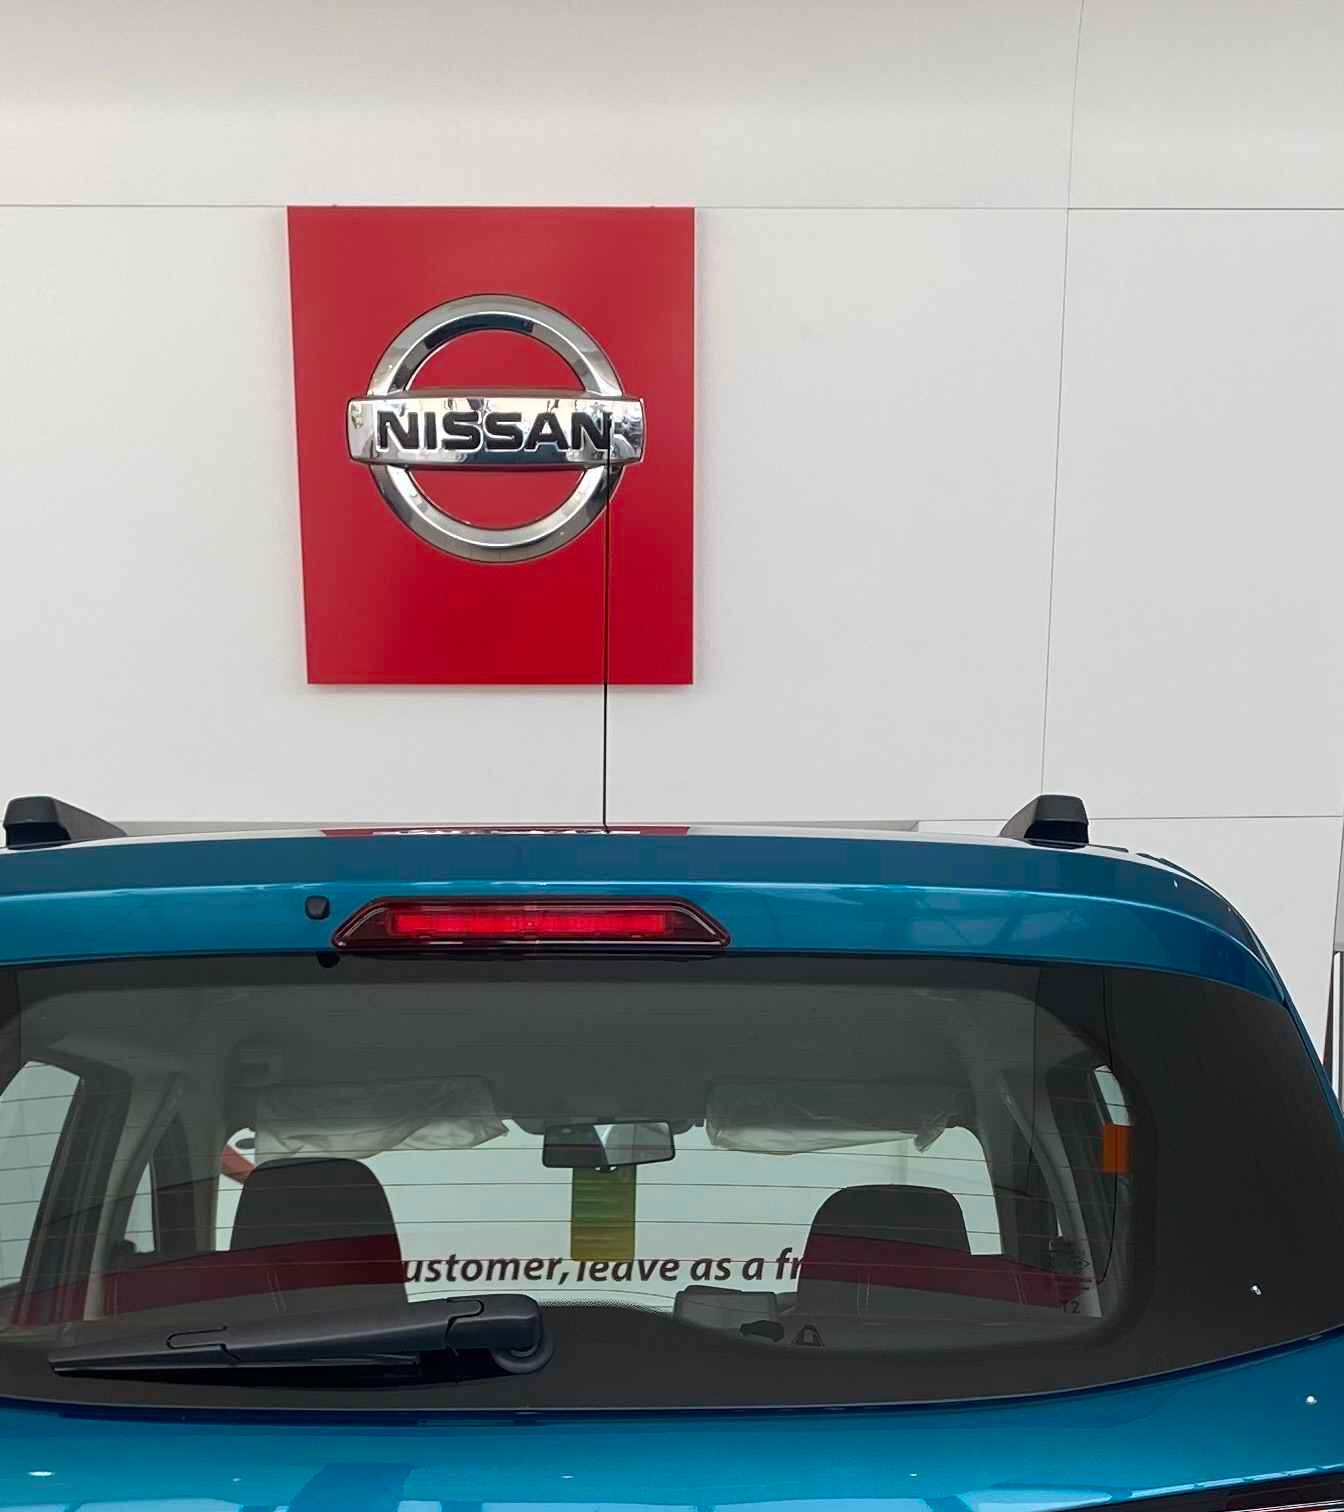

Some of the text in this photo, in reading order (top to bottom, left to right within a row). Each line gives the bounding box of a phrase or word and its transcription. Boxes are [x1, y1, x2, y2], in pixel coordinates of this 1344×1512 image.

[377, 411, 611, 450] NISSAN
[576, 1258, 680, 1282] leave
[690, 1257, 732, 1282] as
[742, 1257, 765, 1281] a
